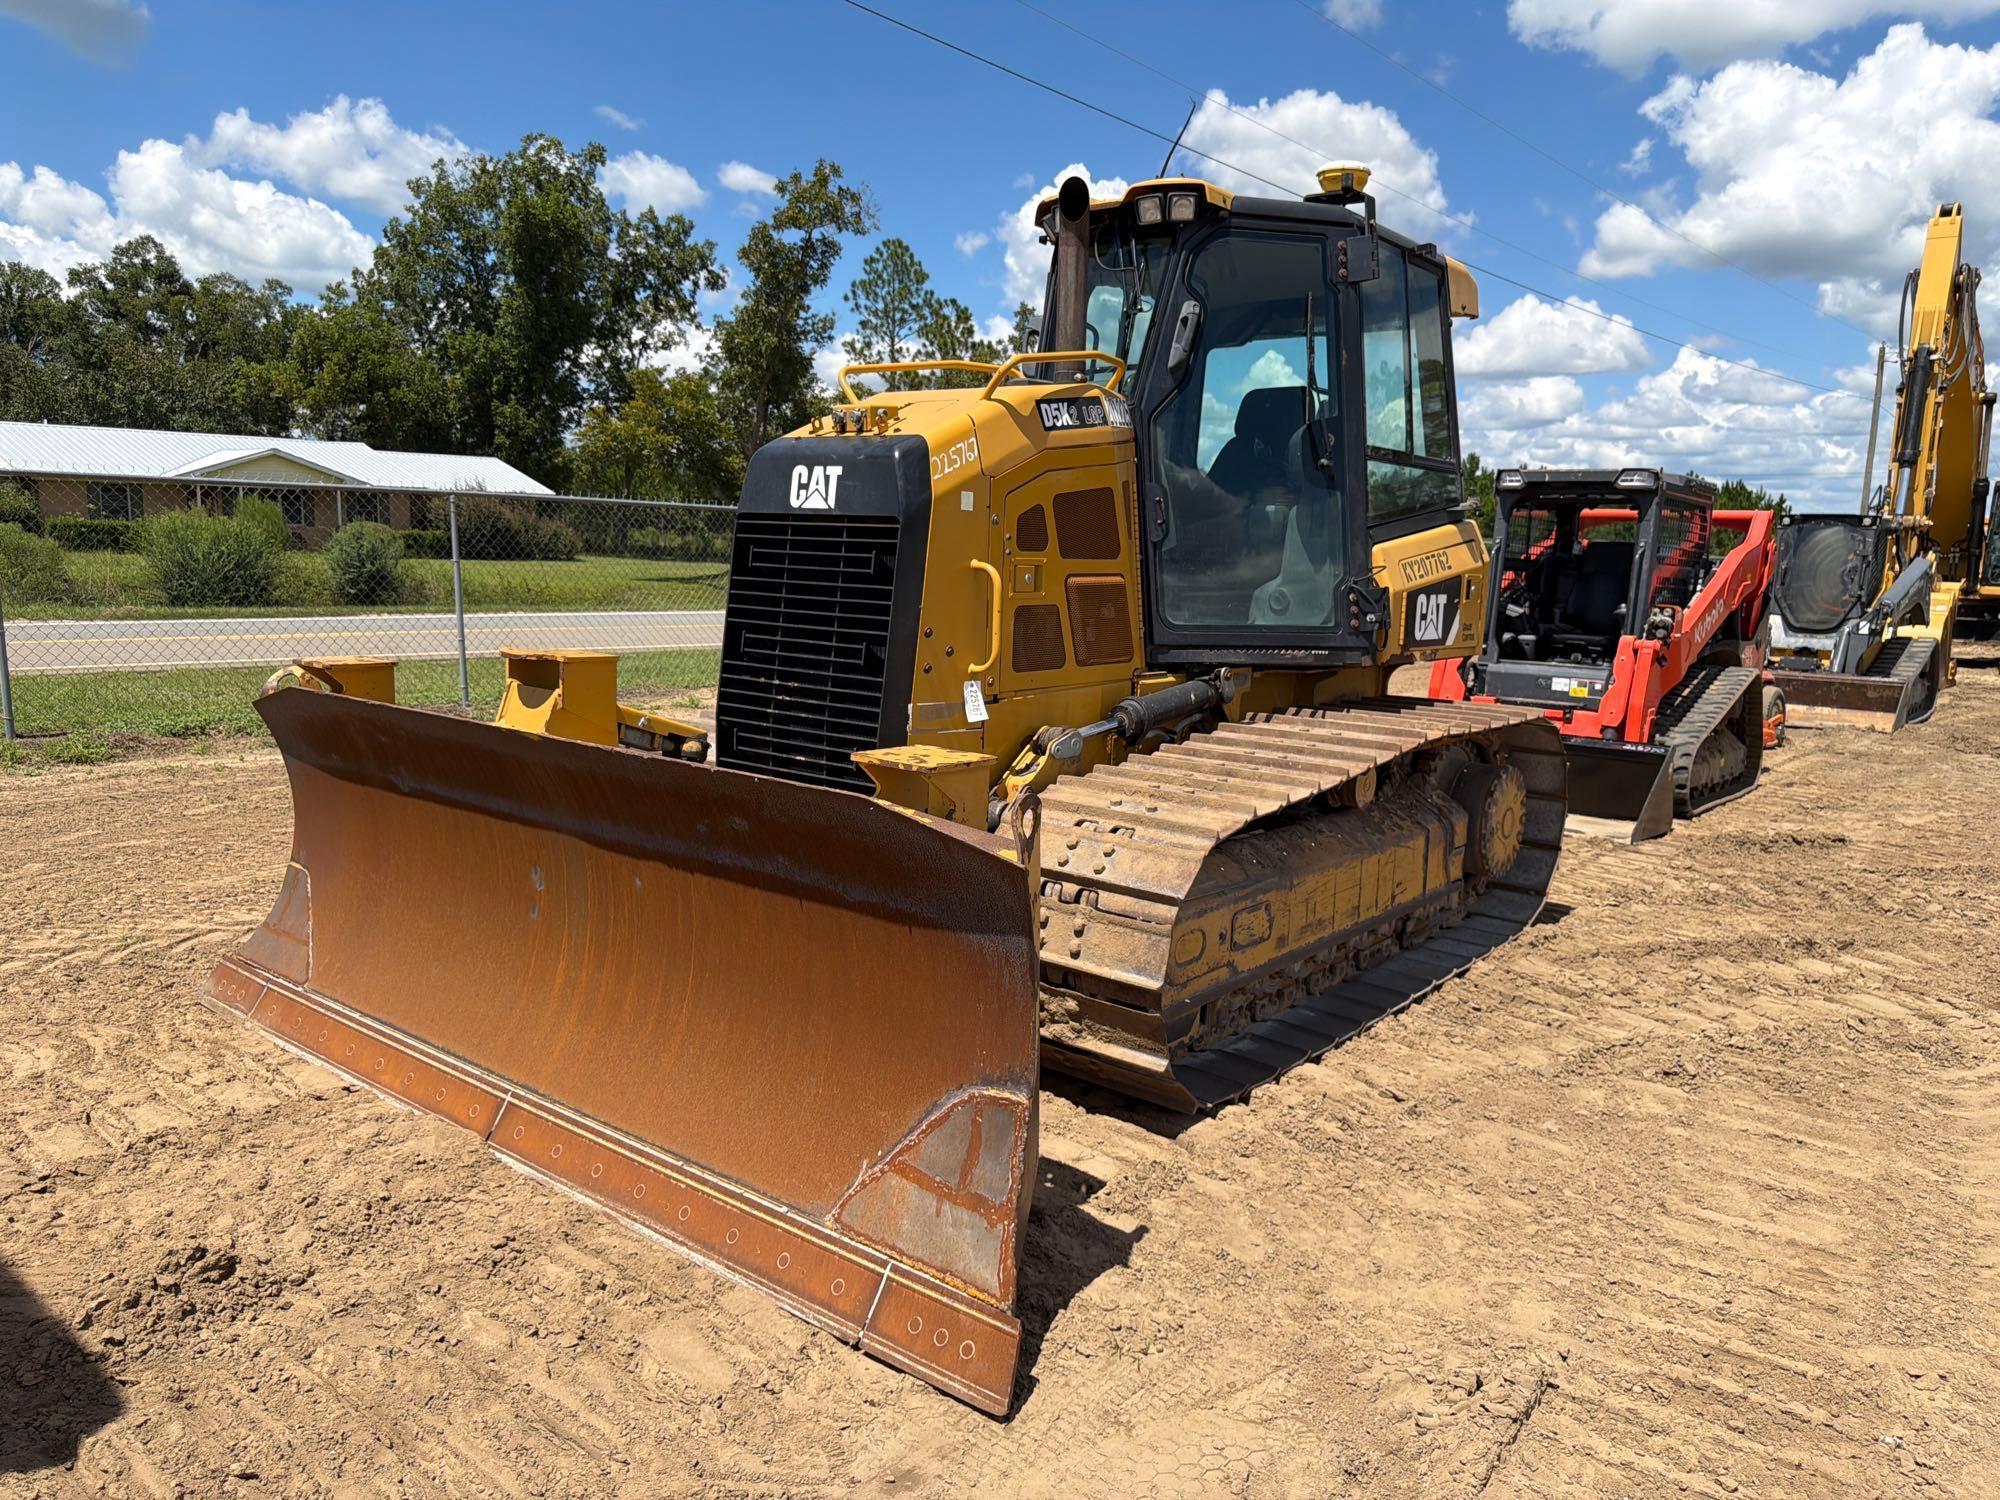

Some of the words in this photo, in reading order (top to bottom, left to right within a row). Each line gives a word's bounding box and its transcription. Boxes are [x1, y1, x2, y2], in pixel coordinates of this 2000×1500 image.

[931, 437, 978, 480] 225767
[790, 464, 843, 509] CAT
[1415, 593, 1448, 641] CAT
[1694, 598, 1724, 643] Kubota
